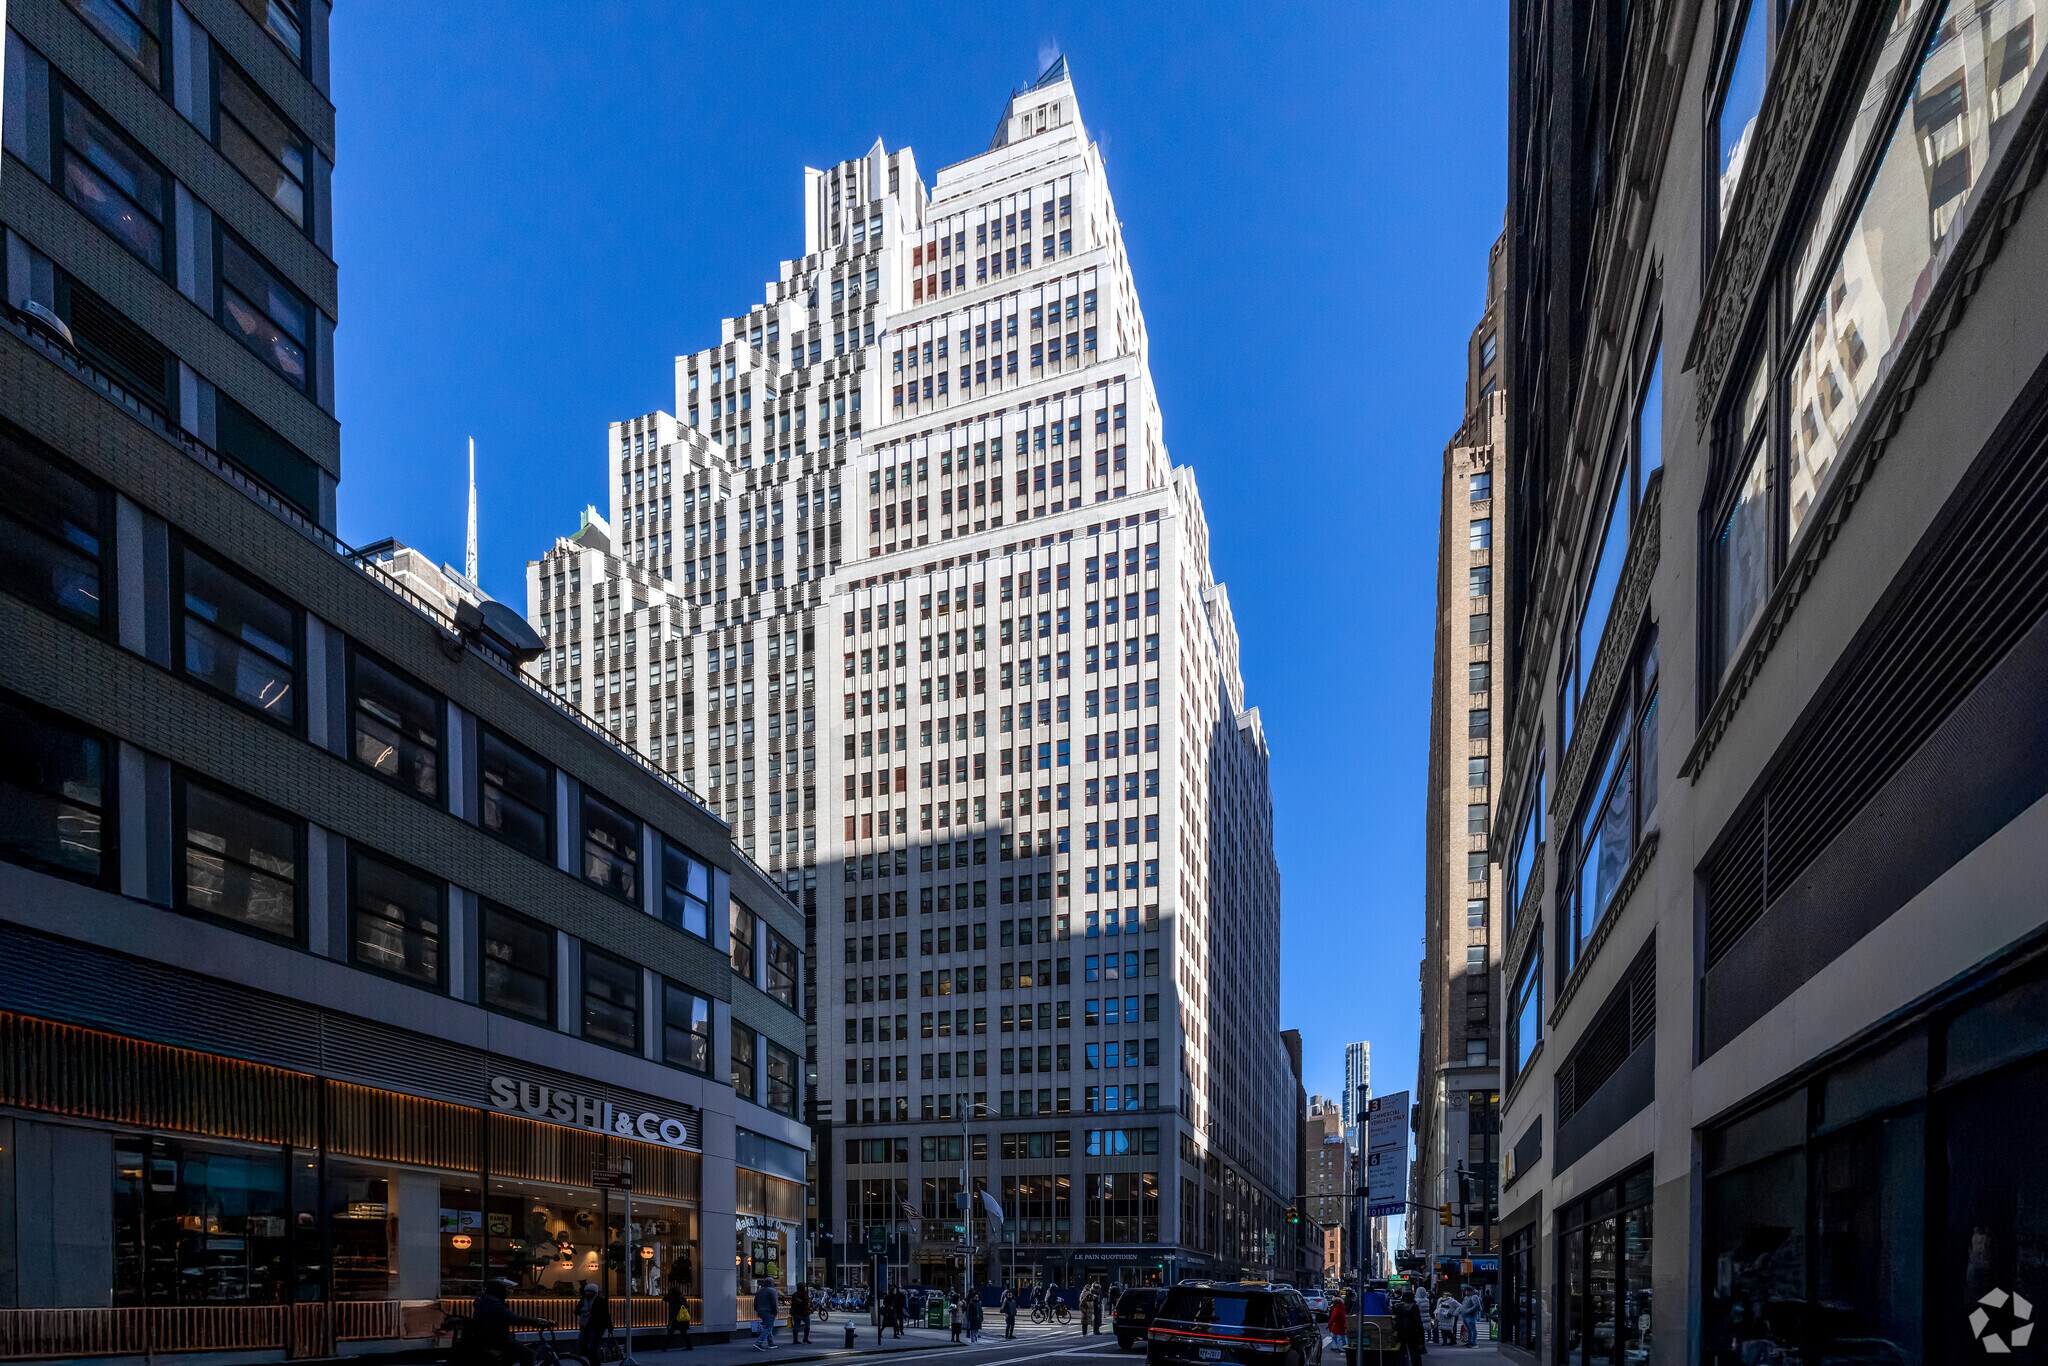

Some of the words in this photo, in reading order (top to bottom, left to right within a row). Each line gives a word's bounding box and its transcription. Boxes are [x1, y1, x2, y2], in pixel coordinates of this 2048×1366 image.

[490, 1075, 687, 1145] SUSHI&CO
[1371, 1100, 1379, 1111] 3
[1371, 1109, 1400, 1120] COMMERCIAL
[1371, 1117, 1392, 1126] VEHICLES
[1393, 1113, 1406, 1121] ONLY
[1371, 1155, 1378, 1166] 6
[736, 1216, 755, 1231] Make
[756, 1215, 774, 1227] Your
[747, 1227, 766, 1239] SUSHI
[767, 1230, 779, 1240] BOX
